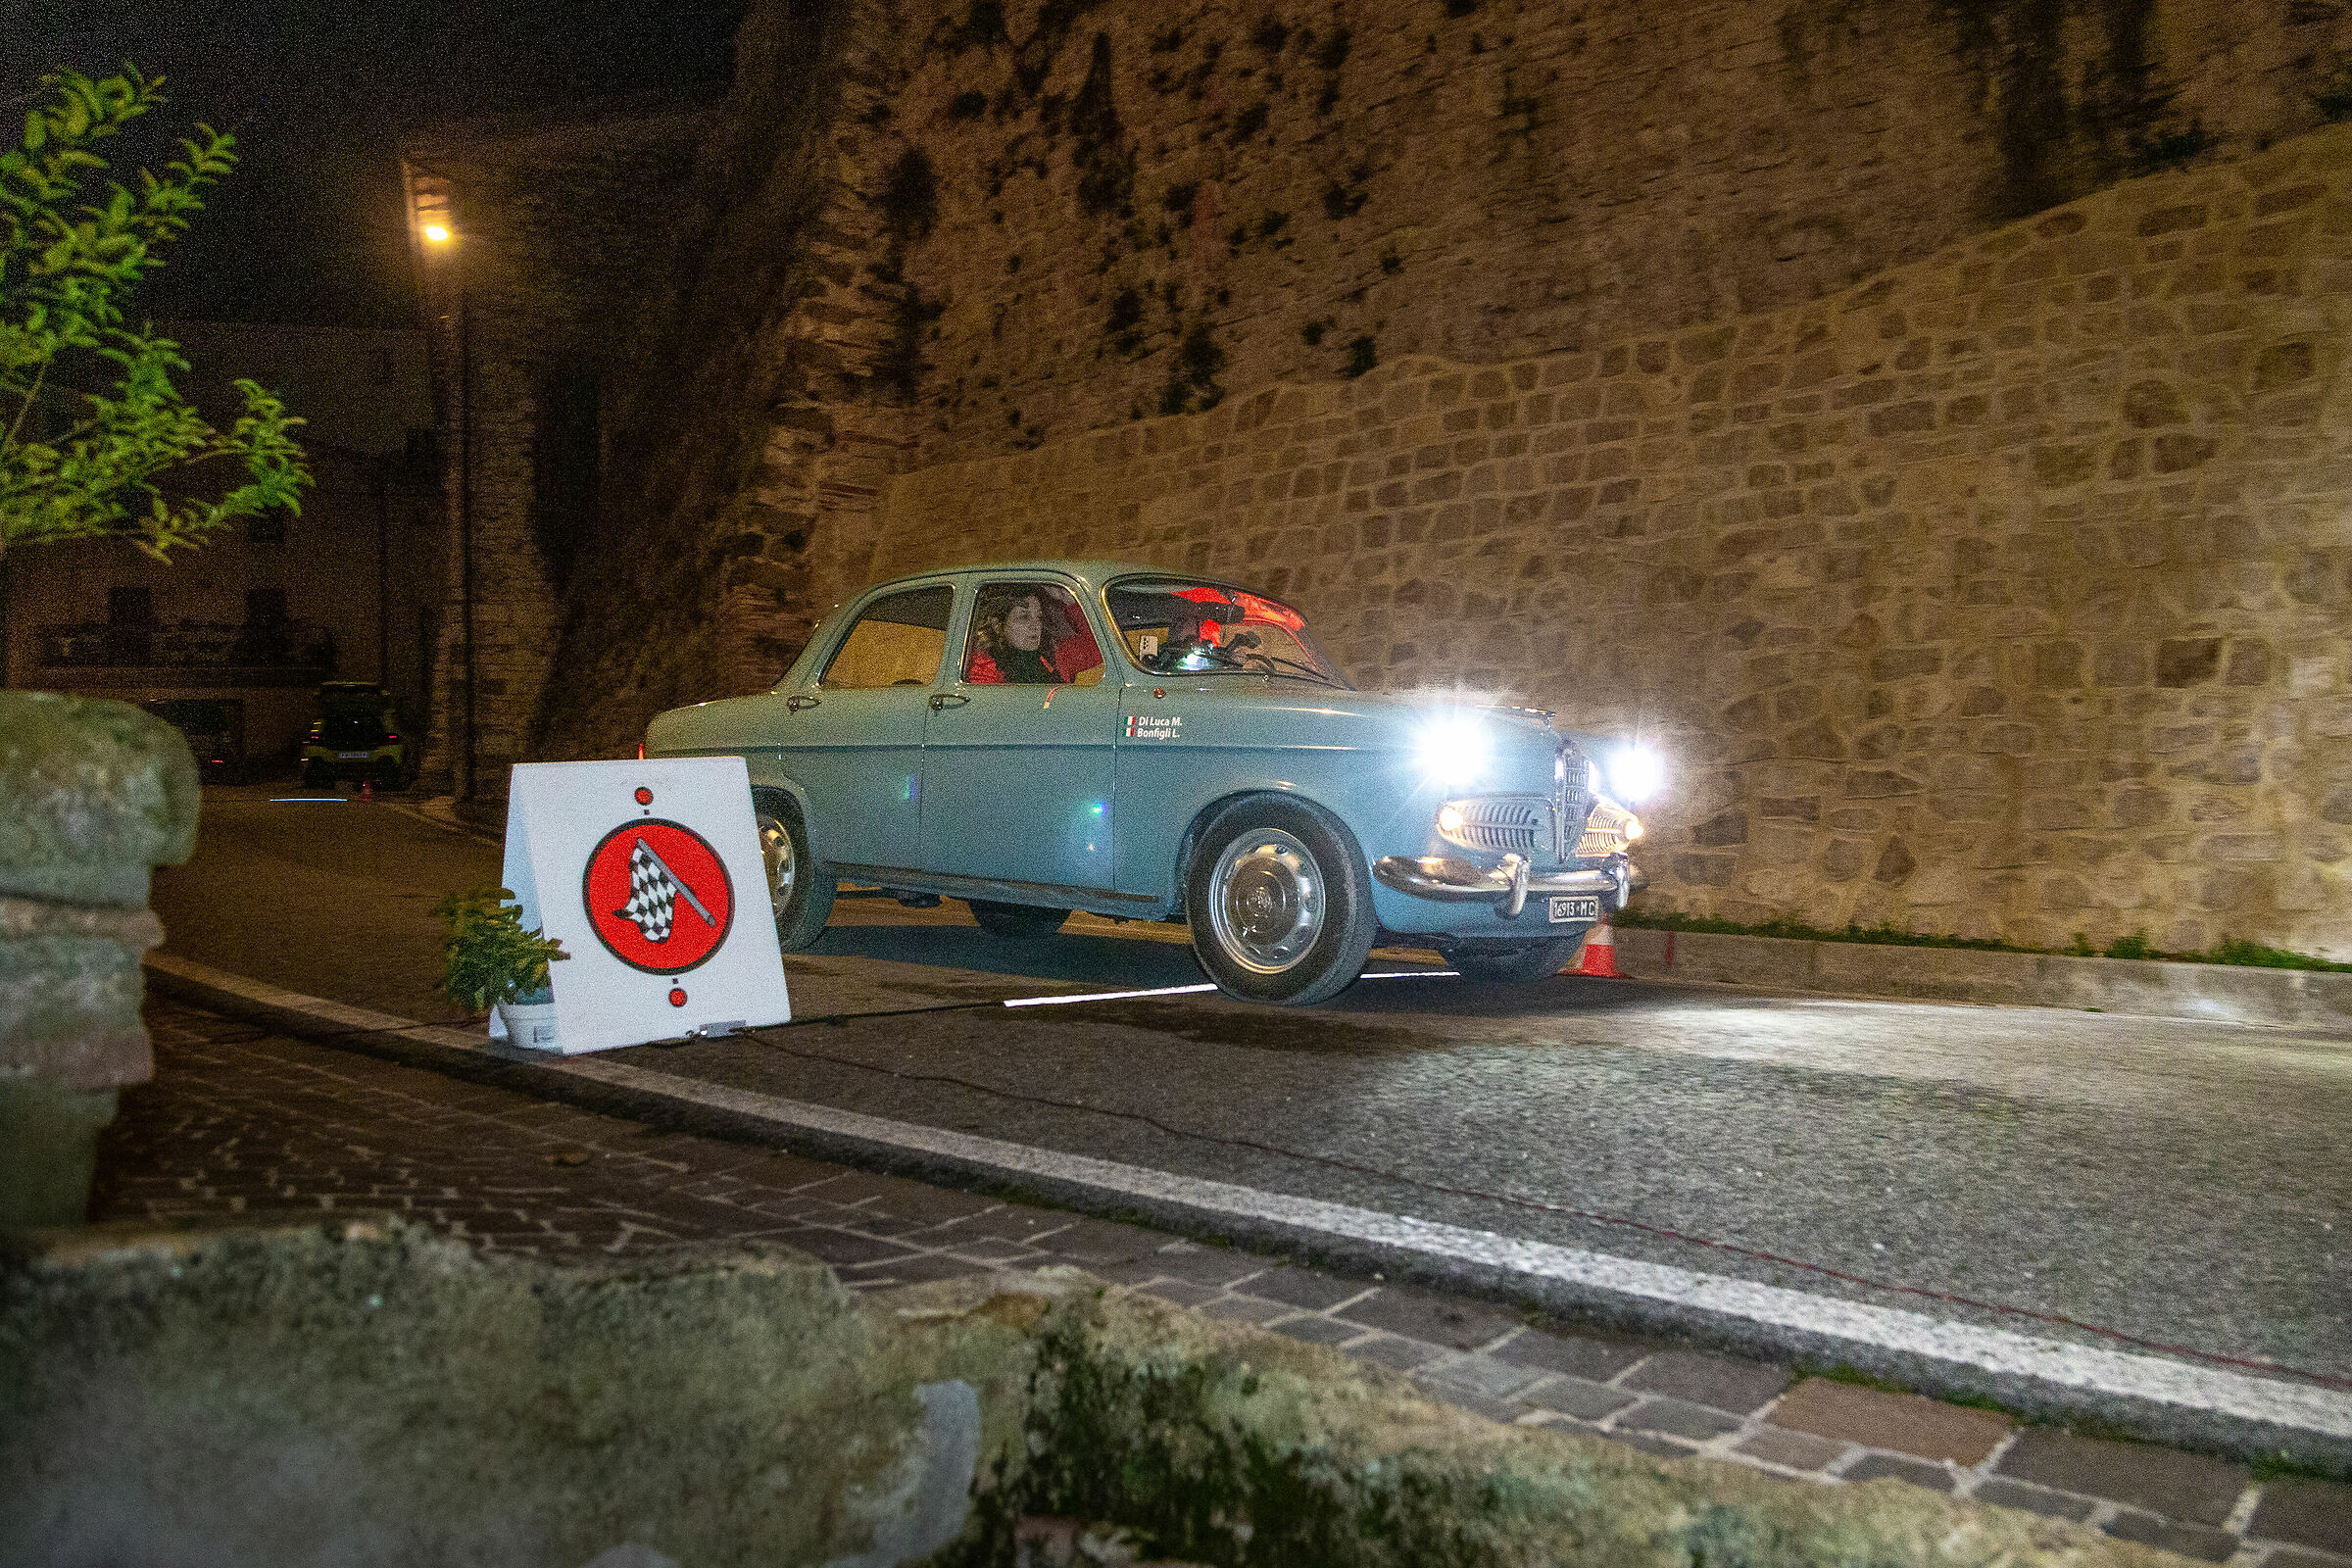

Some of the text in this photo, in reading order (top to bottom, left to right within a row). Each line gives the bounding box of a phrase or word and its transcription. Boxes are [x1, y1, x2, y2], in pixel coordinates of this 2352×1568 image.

[1138, 715, 1183, 726] Di Luca M.
[1137, 727, 1181, 740] Bonfigli L.
